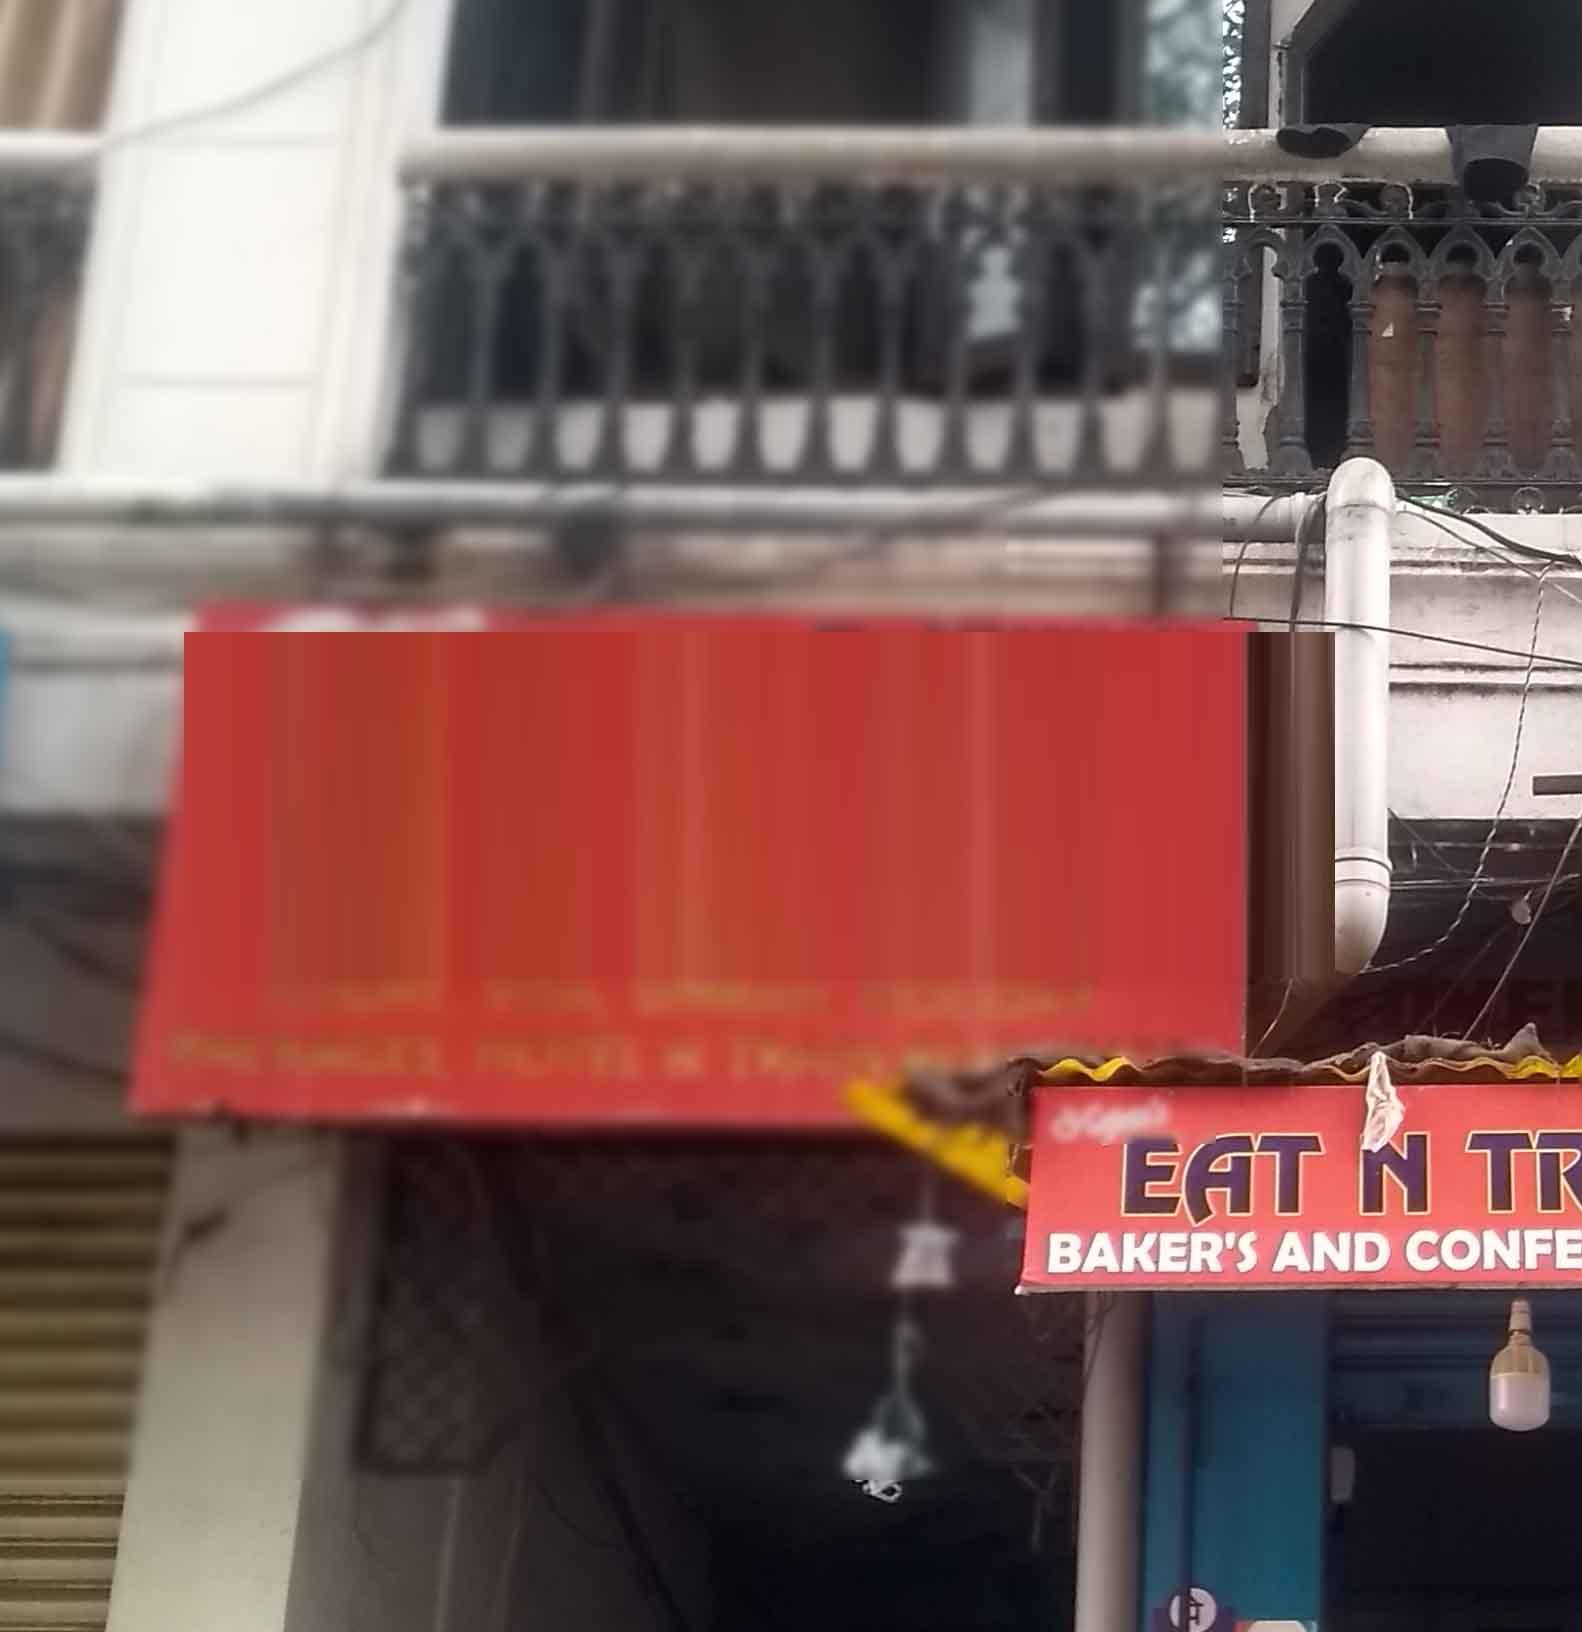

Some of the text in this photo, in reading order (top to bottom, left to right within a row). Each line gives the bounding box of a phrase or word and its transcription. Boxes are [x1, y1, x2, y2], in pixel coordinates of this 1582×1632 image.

[1121, 1132, 1326, 1227] EAT
[1359, 1131, 1431, 1217] N
[1047, 1231, 1258, 1274] BAKER'S
[1271, 1230, 1391, 1273] AND
